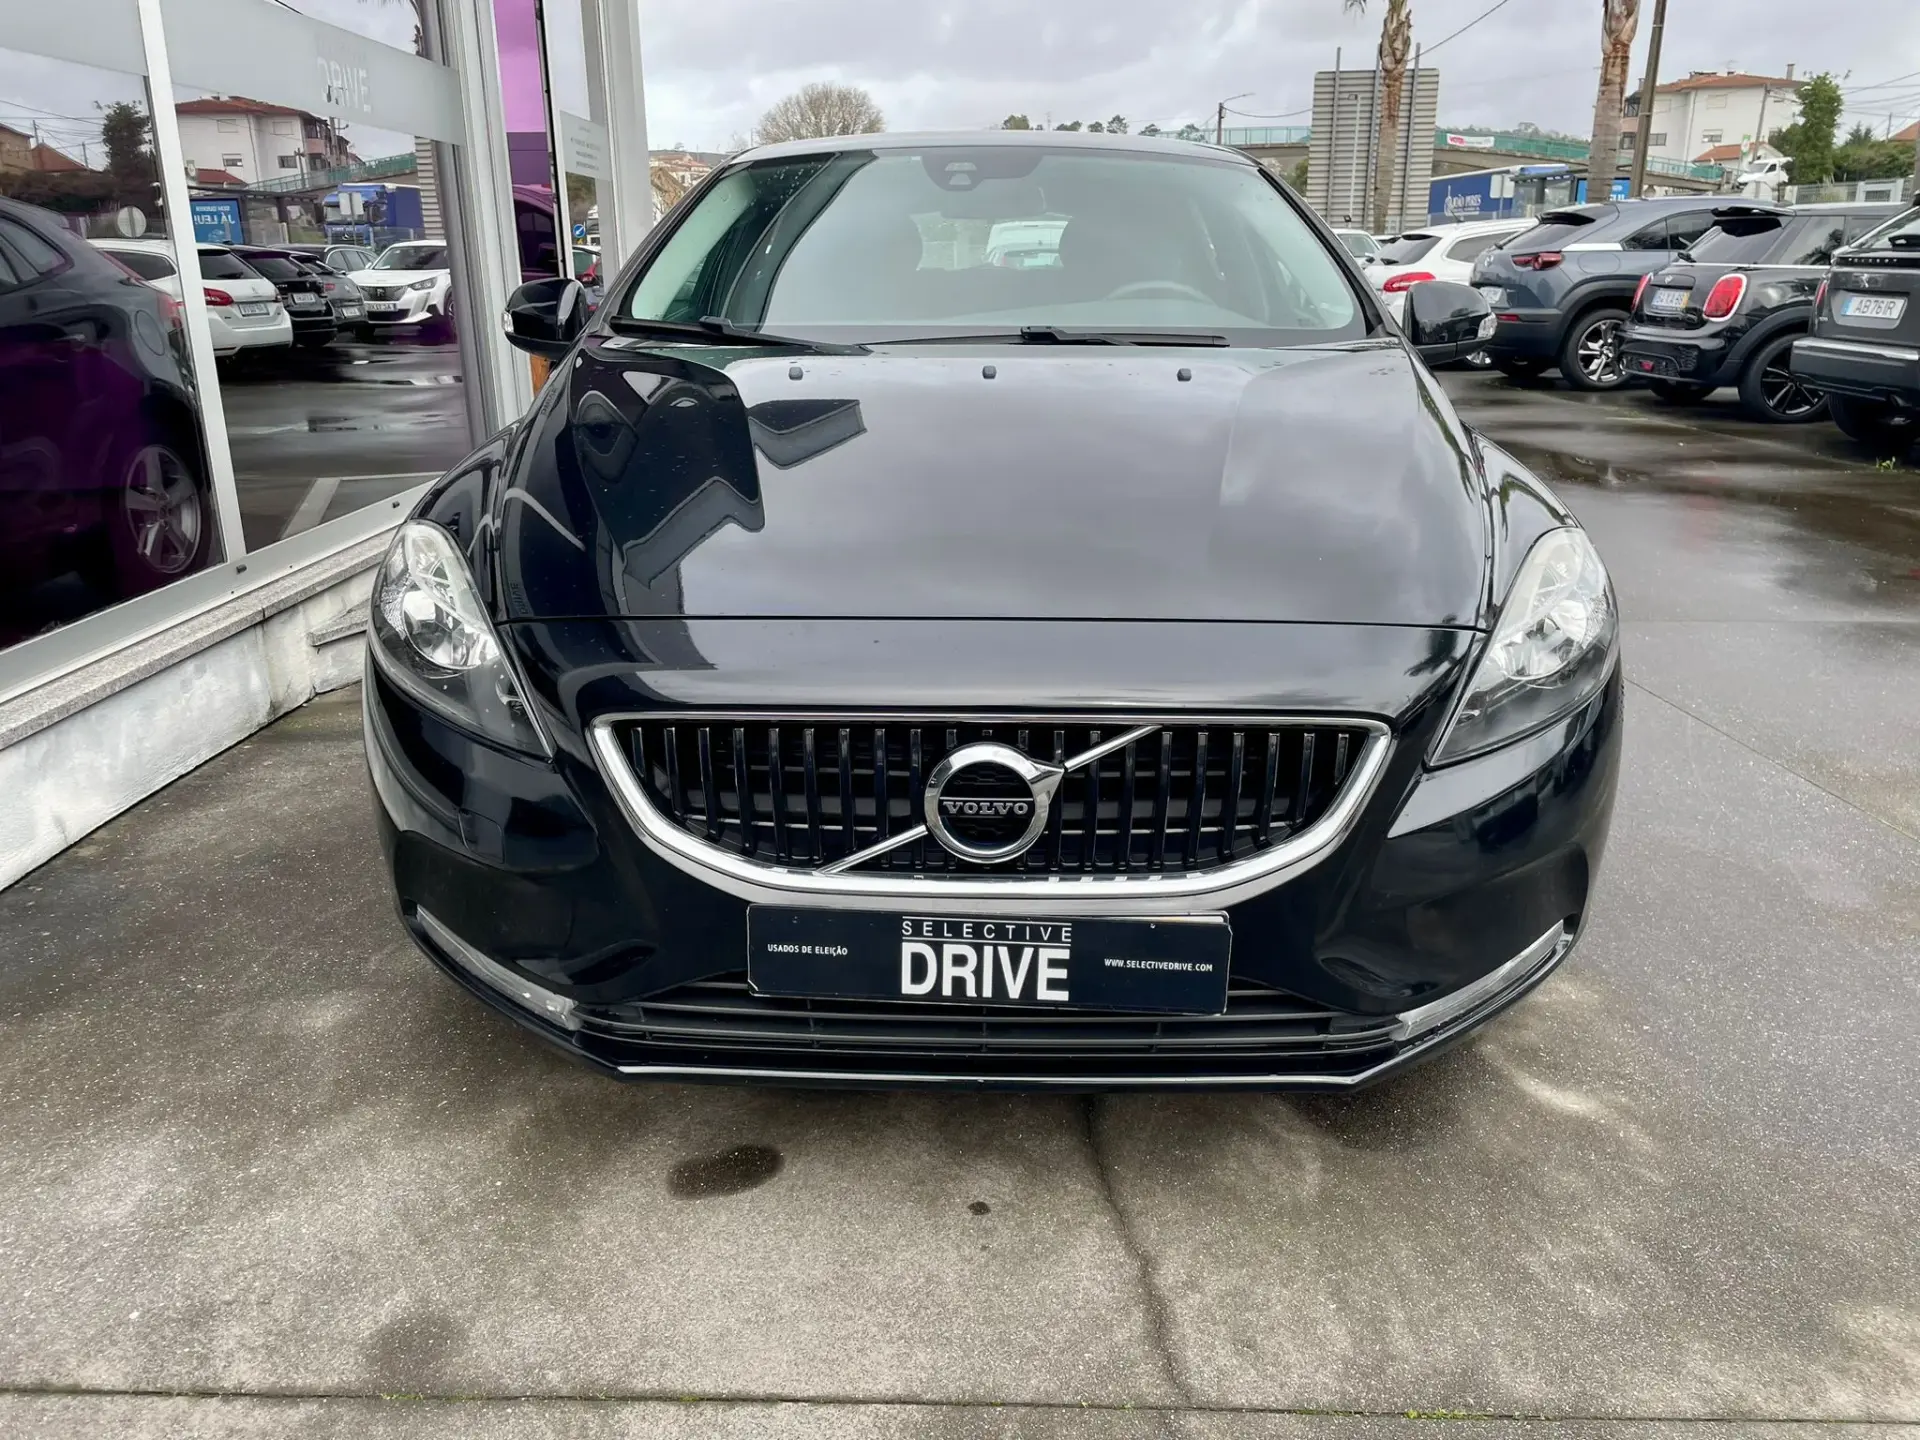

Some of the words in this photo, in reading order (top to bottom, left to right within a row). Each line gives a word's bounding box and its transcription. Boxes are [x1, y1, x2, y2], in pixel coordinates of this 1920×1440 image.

[943, 802, 1028, 815] VOLVO
[902, 920, 1072, 942] SELECTIVE
[767, 943, 799, 954] USADOS
[801, 945, 812, 954] DE
[815, 944, 848, 957] ELEIÇÃO
[901, 941, 1071, 1001] DRIVE
[1104, 958, 1213, 972] WWW.SELECTIVEDRIVE.COM
